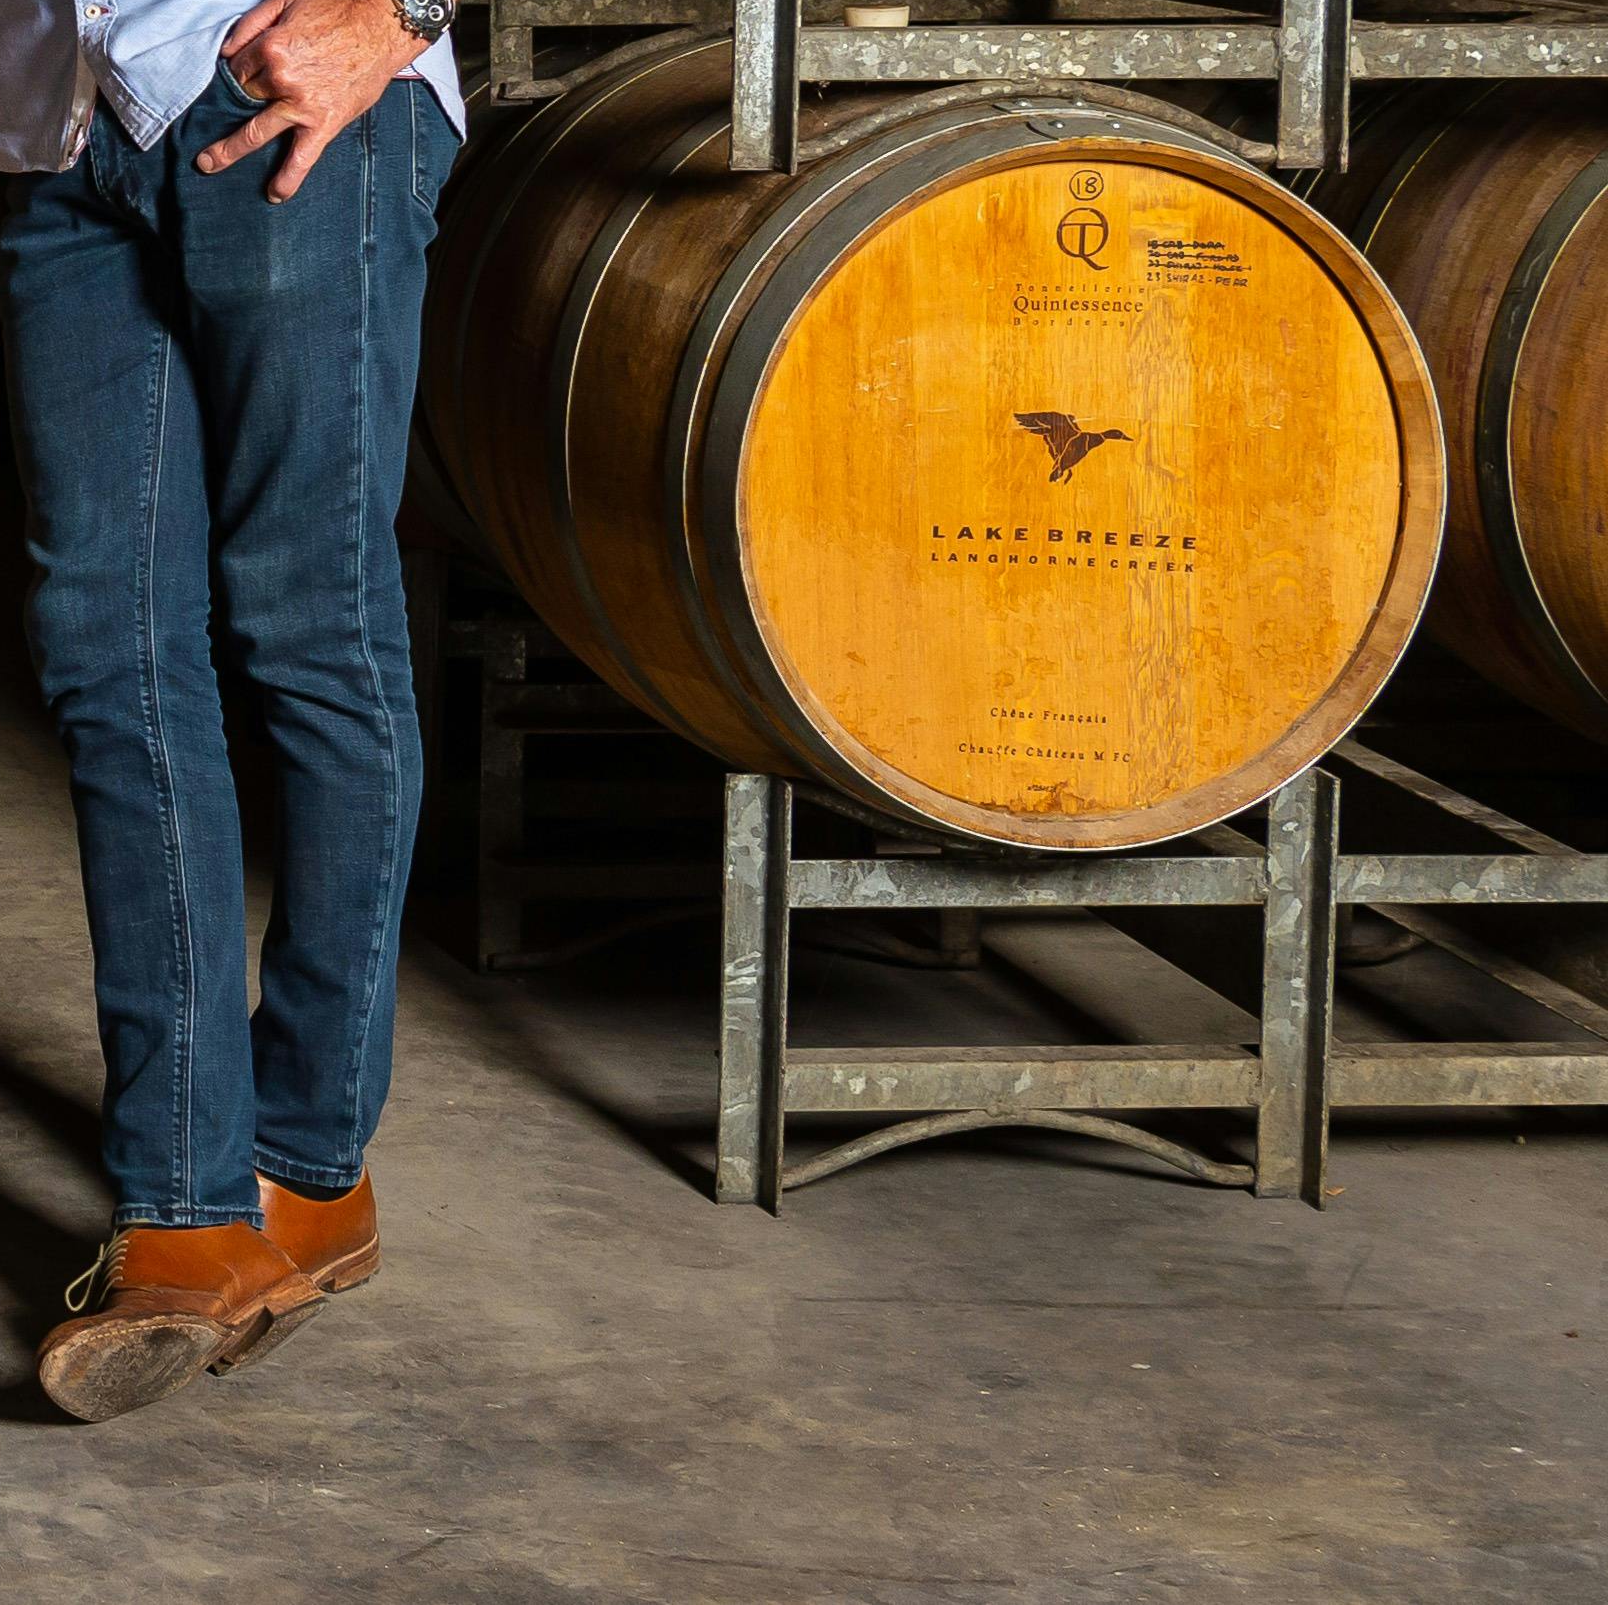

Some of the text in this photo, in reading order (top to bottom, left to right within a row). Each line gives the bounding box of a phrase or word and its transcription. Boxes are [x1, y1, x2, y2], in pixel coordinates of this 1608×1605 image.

[1076, 177, 1097, 194] 18
[1147, 272, 1248, 287] 23 SHIRAZ PEAR
[1016, 283, 1145, 294] Tonnellerie
[1014, 295, 1144, 313] Quintessence
[932, 525, 1196, 550] LAKE BREEZE
[931, 552, 1194, 573] LANGHORNE CREEK
[990, 707, 1107, 724] Chêne Français
[958, 743, 1131, 763] Chauffe Château M FC
